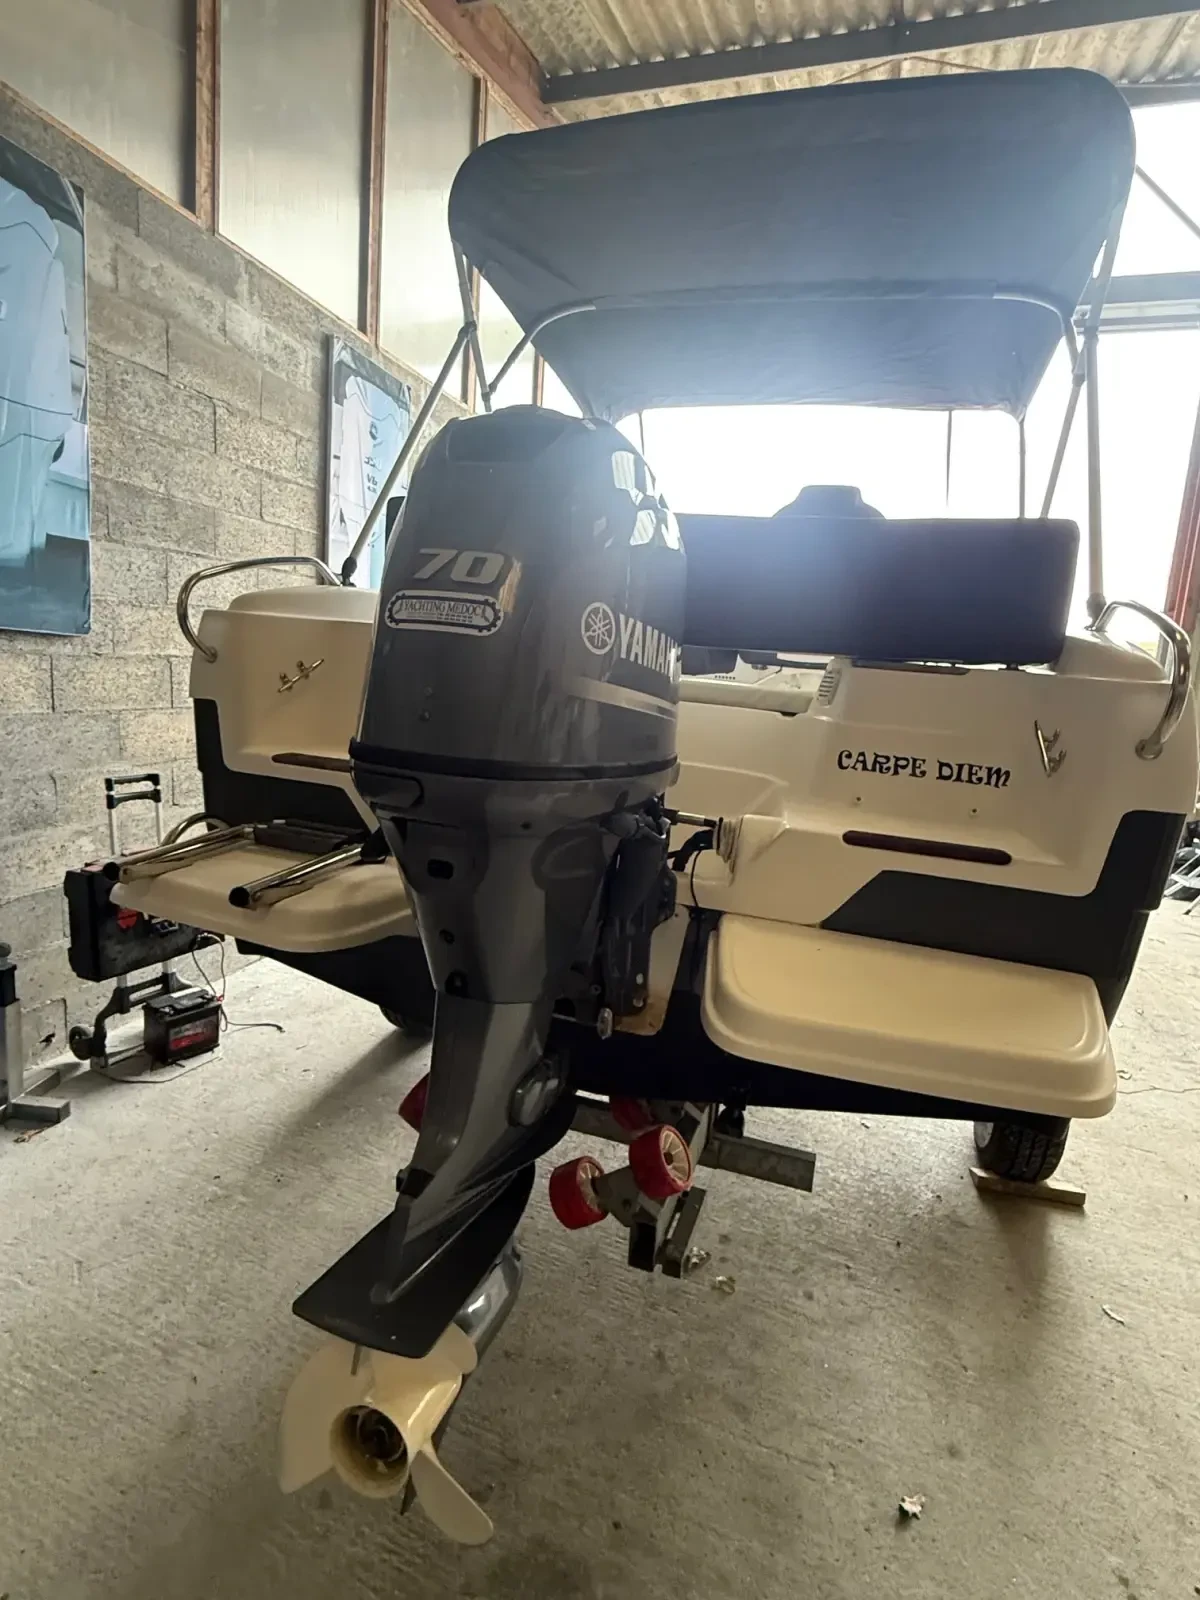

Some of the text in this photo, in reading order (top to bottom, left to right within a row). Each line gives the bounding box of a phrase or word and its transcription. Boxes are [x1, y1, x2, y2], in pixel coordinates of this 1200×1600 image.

[413, 548, 505, 584] 70
[404, 599, 446, 613] YACHTING
[446, 602, 481, 617] MEDOC
[837, 750, 1011, 789] CARPE DIEM
